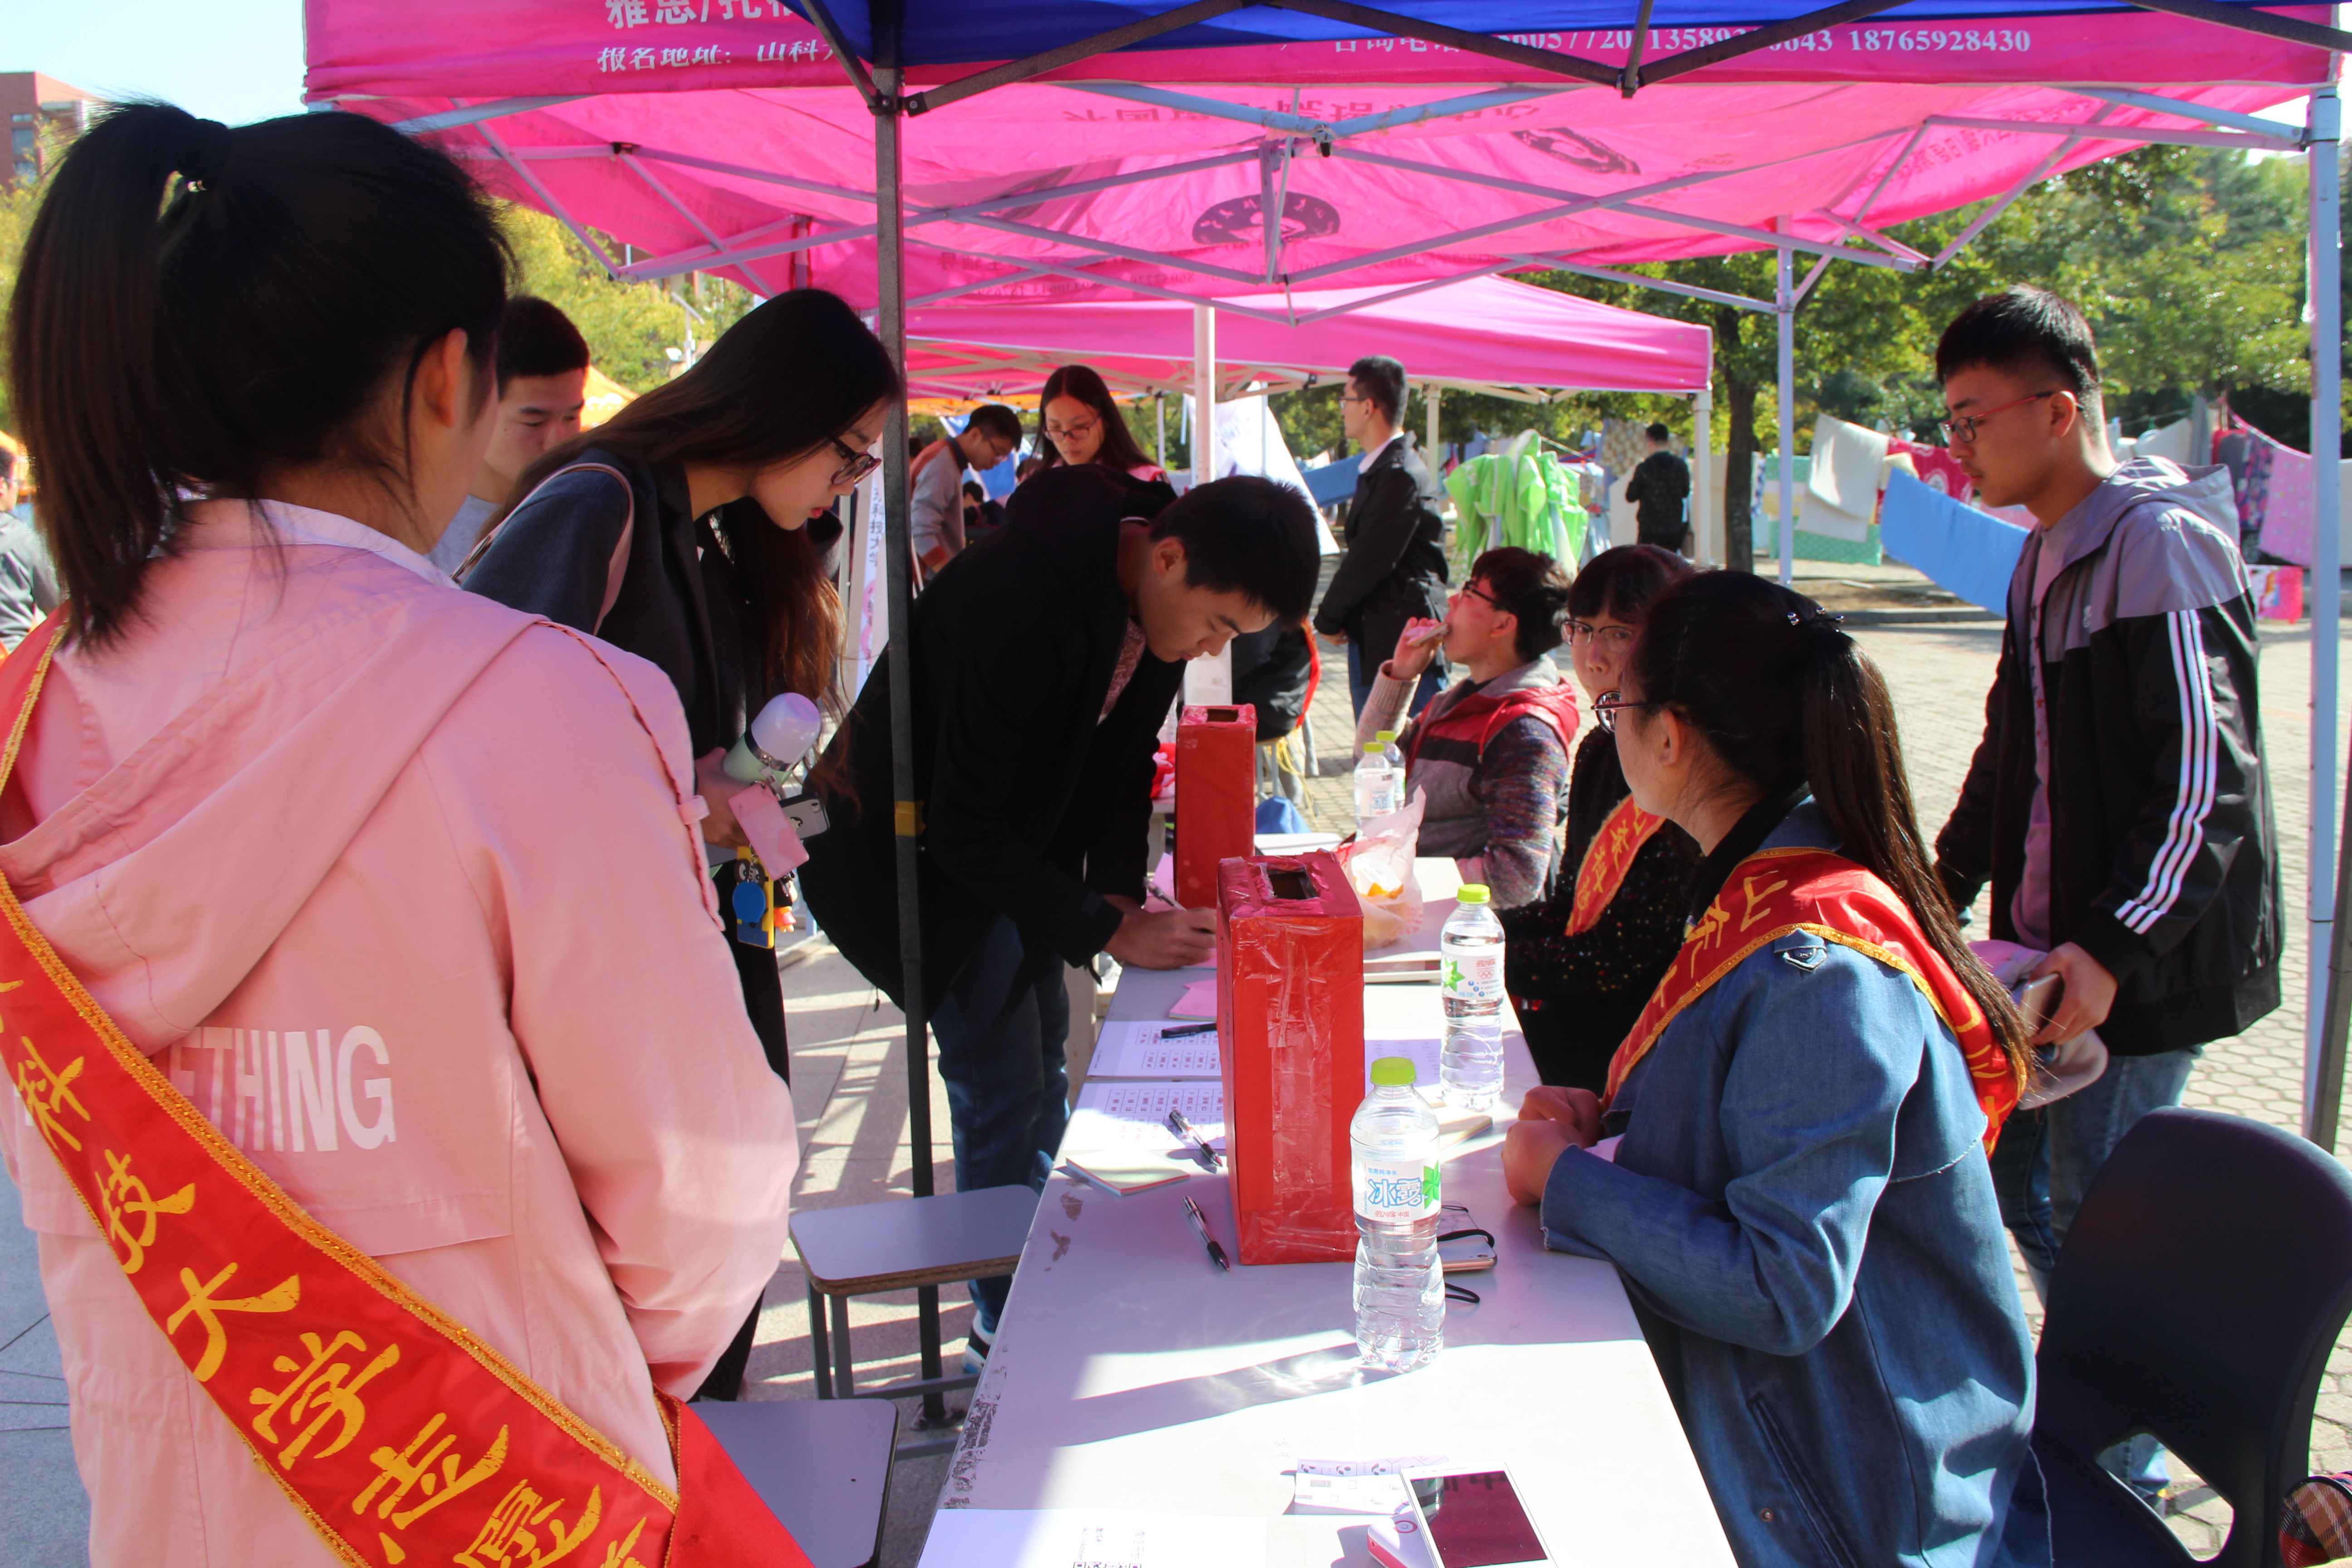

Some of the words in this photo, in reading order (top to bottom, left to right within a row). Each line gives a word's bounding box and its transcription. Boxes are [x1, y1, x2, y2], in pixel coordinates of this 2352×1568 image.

[1849, 29, 2030, 52] 18765928430
[1368, 1167, 1398, 1176] 饮用纯净水
[1367, 1176, 1422, 1208] 冰露
[0, 980, 647, 1568] 科技大学志愿
